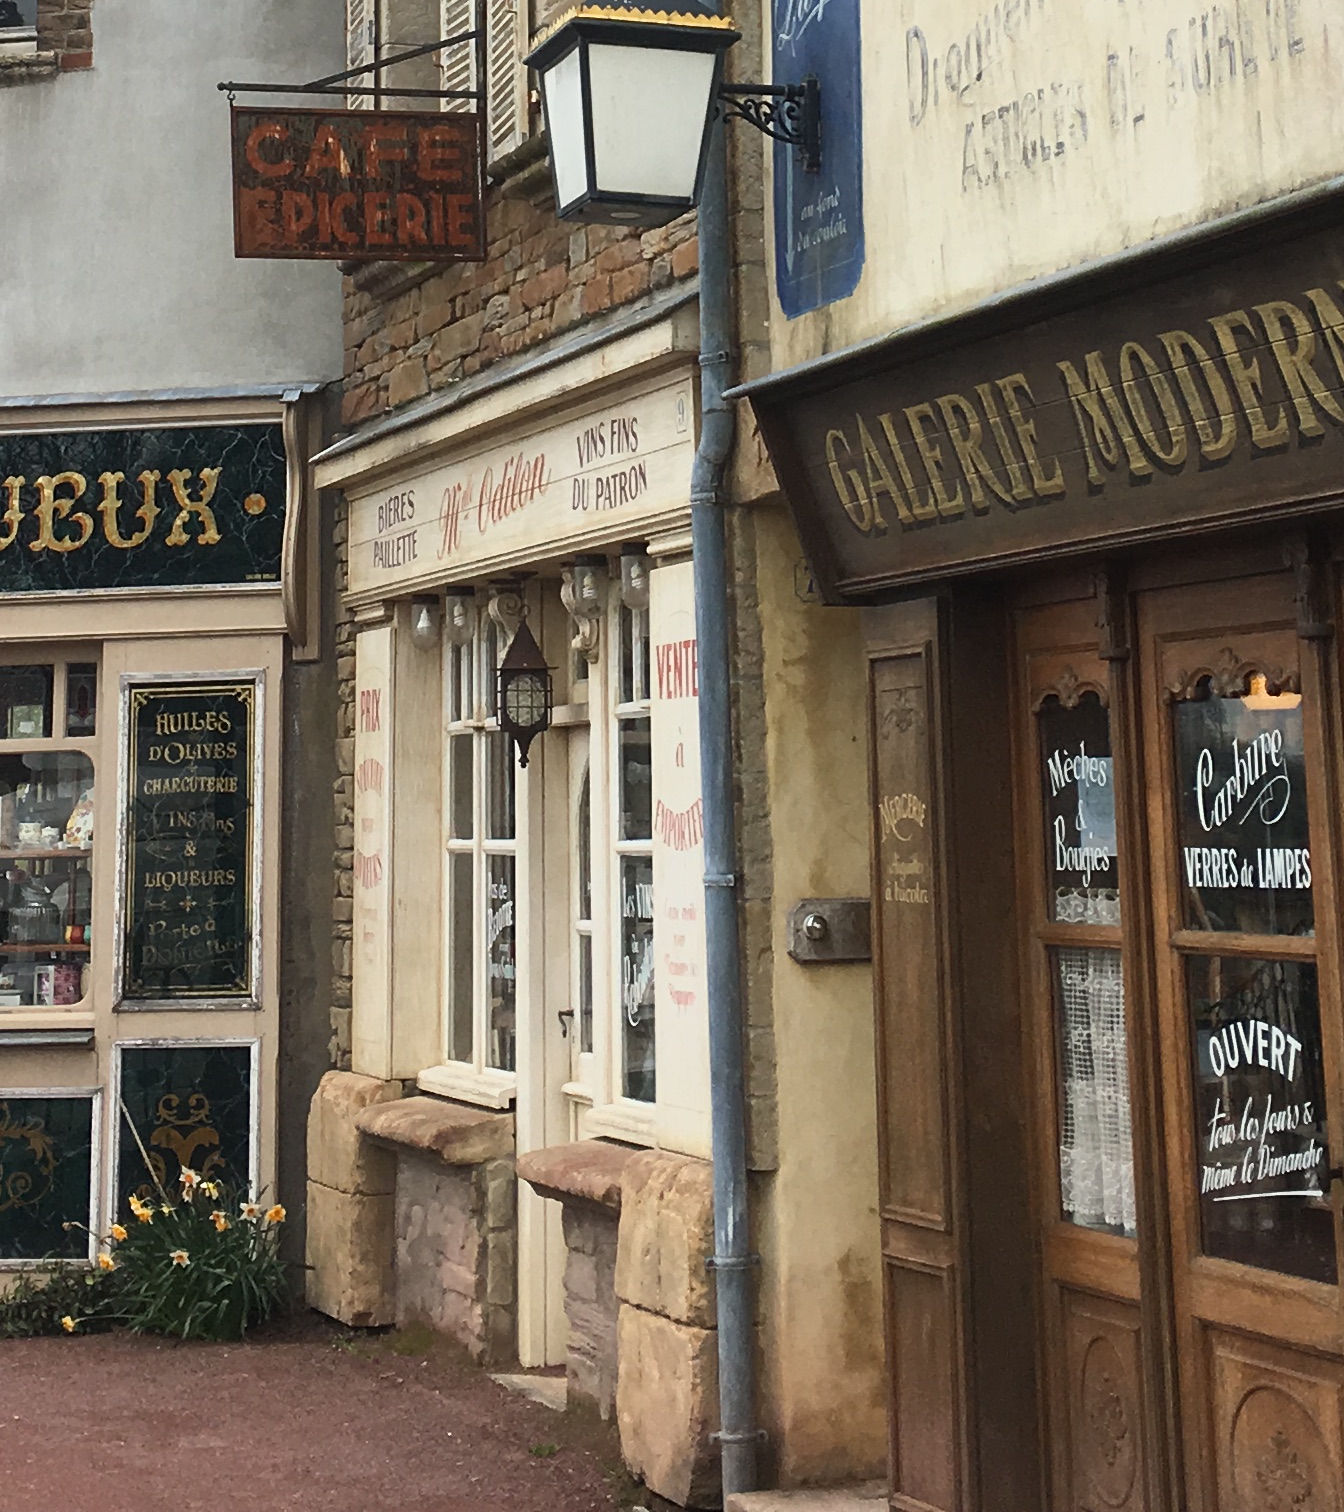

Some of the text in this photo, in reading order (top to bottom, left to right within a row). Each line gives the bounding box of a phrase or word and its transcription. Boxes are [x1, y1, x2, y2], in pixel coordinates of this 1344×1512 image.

[245, 121, 463, 182] CAFE
[677, 397, 685, 426] 9
[576, 416, 639, 469] VINS FINS
[823, 373, 1066, 533] GALERIE
[478, 451, 552, 536] Odilon
[572, 459, 648, 511] DU PATRON
[373, 529, 418, 569] PAILLETTE
[656, 638, 698, 701] VENTE
[156, 711, 232, 736] HUILES
[144, 776, 238, 795] CHARCUTERIE
[1047, 740, 1107, 796] Mèches
[1196, 729, 1291, 832] Carbure
[183, 840, 197, 857] &
[1054, 815, 1110, 888] Bougies
[1183, 846, 1312, 889] VERRES de LAMPES
[144, 869, 237, 892] LIQUEURS
[1208, 1019, 1303, 1083] OUVERT
[1207, 1097, 1236, 1152] tous
[1238, 1096, 1259, 1141] les
[1201, 1138, 1324, 1195] même le Dimanche
